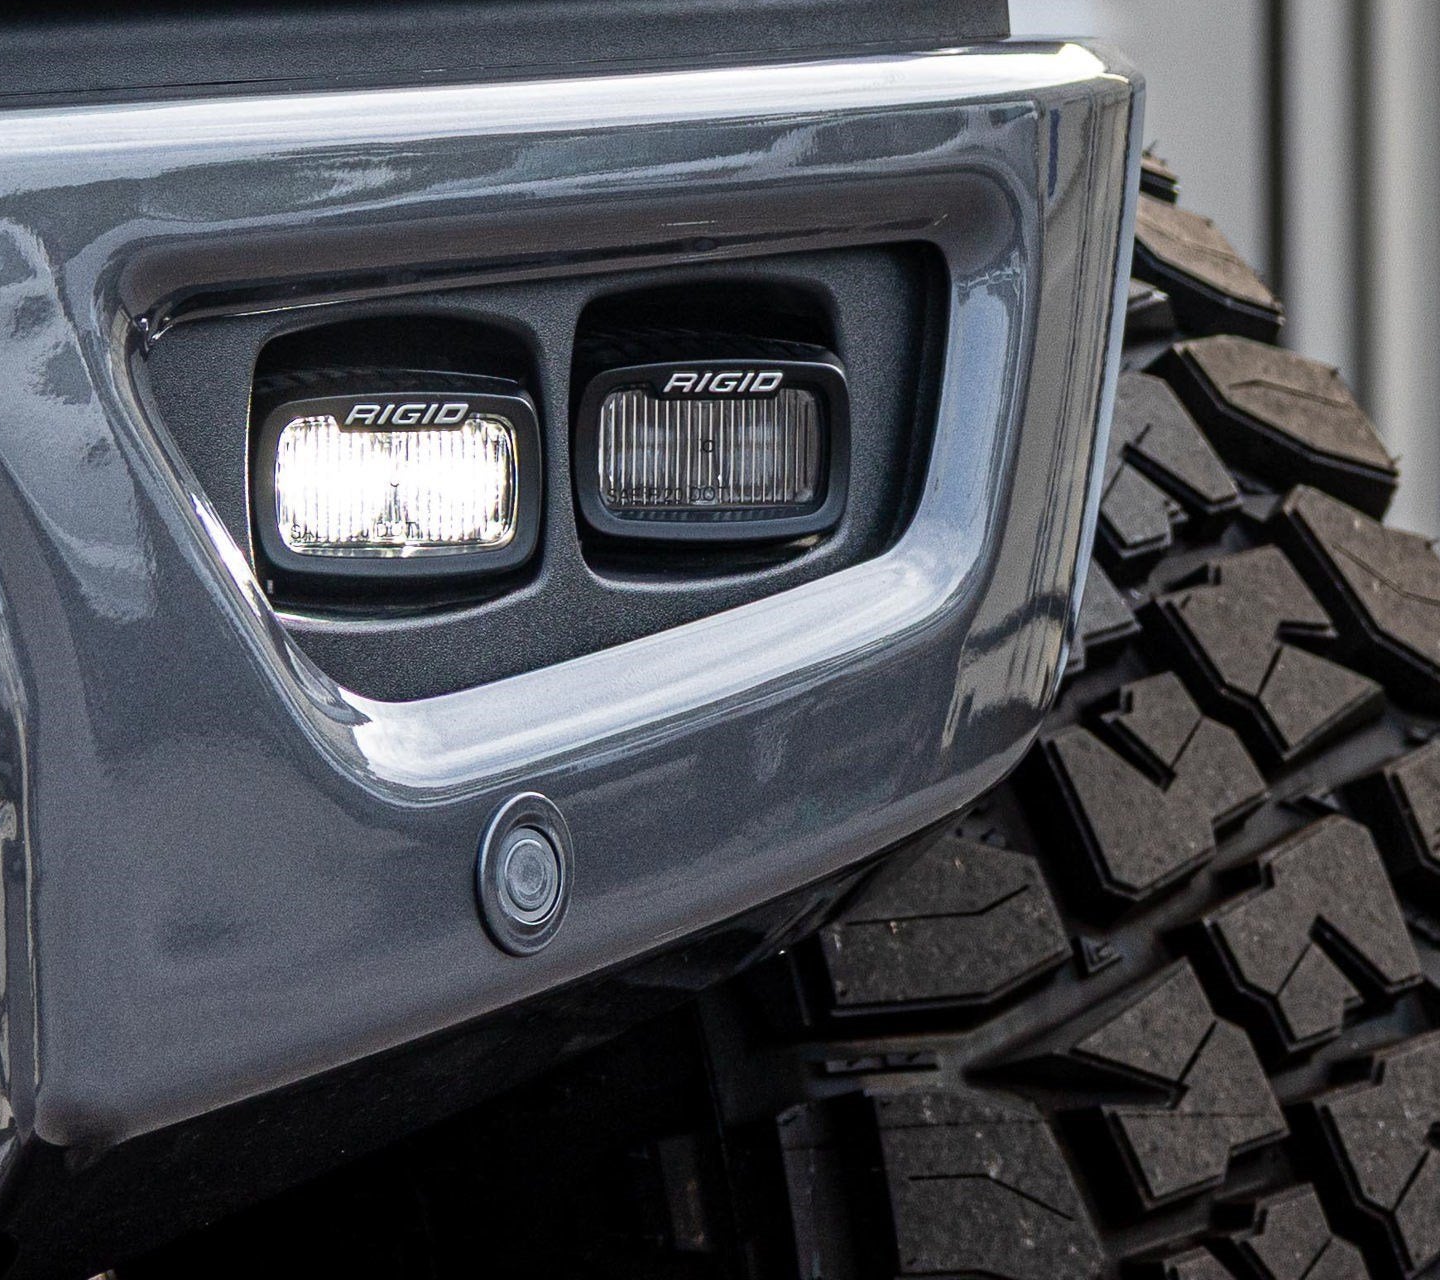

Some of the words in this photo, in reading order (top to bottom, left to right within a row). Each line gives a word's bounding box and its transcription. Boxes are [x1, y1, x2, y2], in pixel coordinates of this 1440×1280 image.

[662, 371, 783, 393] RIGID
[344, 403, 469, 425] RIGID
[690, 484, 727, 503] DOT
